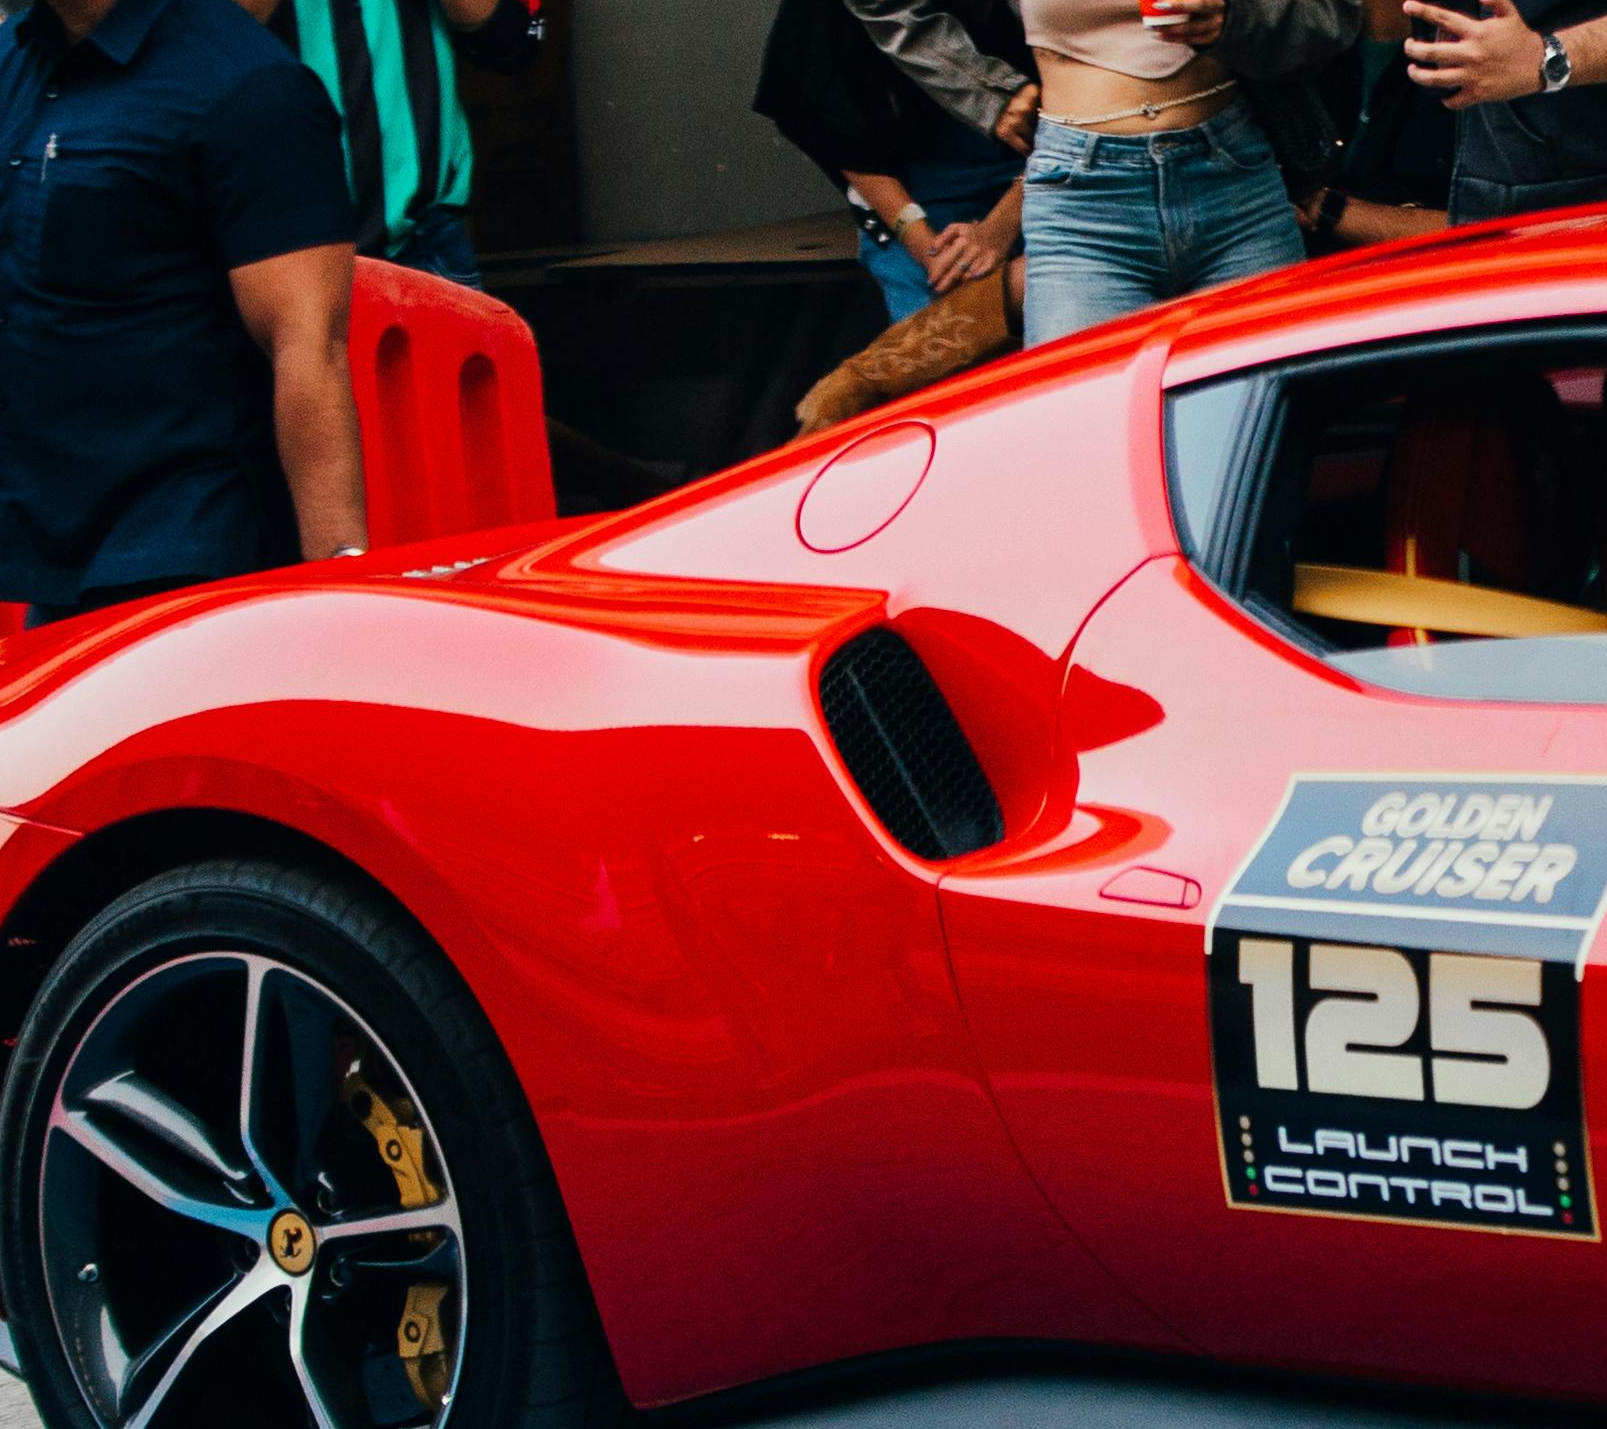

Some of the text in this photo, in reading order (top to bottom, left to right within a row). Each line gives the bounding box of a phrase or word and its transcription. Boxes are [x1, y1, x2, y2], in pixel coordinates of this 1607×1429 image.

[1360, 791, 1555, 842] GOLDEN
[1285, 834, 1579, 904] CRUISER
[1237, 937, 1552, 1111] 125
[1276, 1124, 1530, 1173] LAUNCH
[1262, 1163, 1555, 1217] CONTROL
